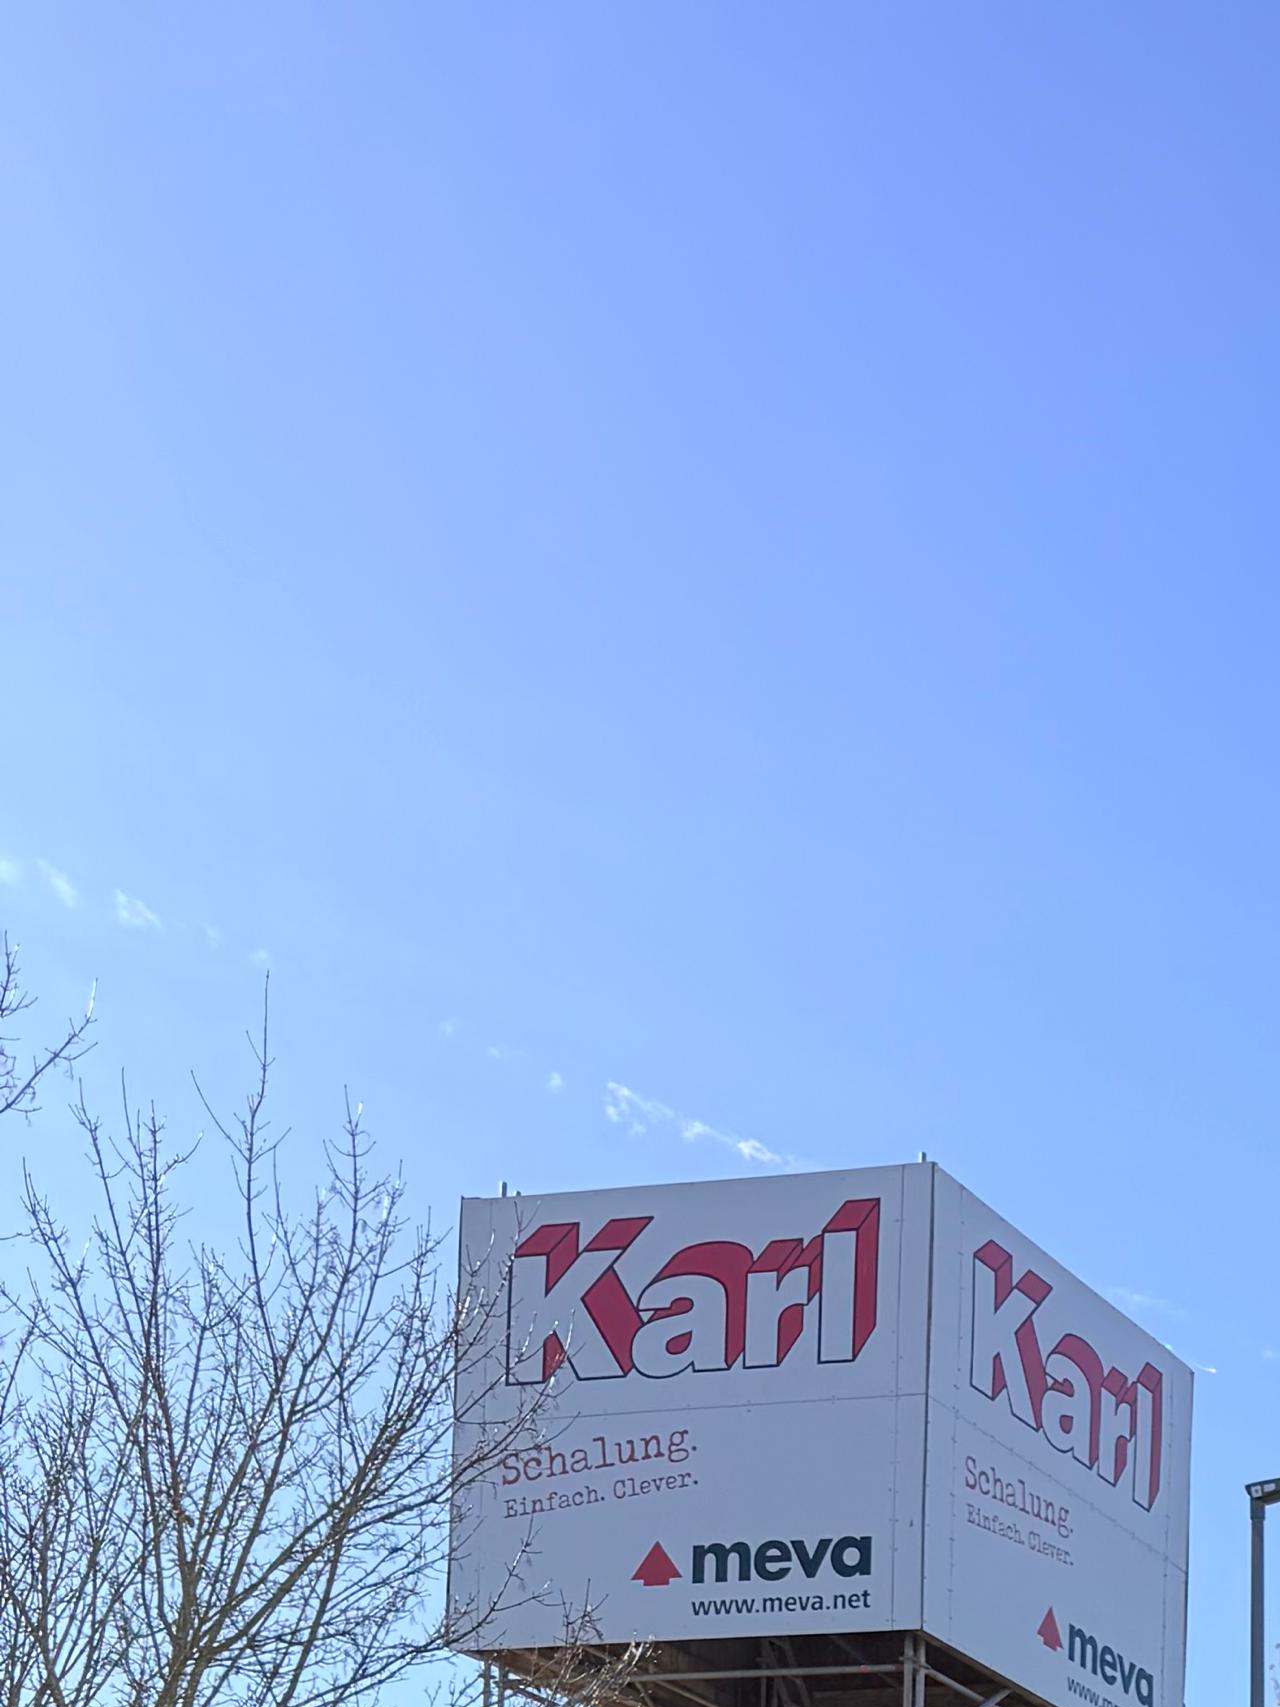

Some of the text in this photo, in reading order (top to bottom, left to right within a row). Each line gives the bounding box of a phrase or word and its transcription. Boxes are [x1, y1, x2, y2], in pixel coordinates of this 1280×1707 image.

[505, 1198, 881, 1386] Karl
[970, 1239, 1163, 1513] Karl
[502, 1429, 698, 1487] Schalung.
[503, 1471, 699, 1519] Einfach. Clever.
[965, 1455, 1074, 1539] Schalung.
[692, 1536, 872, 1584] meva
[691, 1589, 871, 1617] www.meva.net
